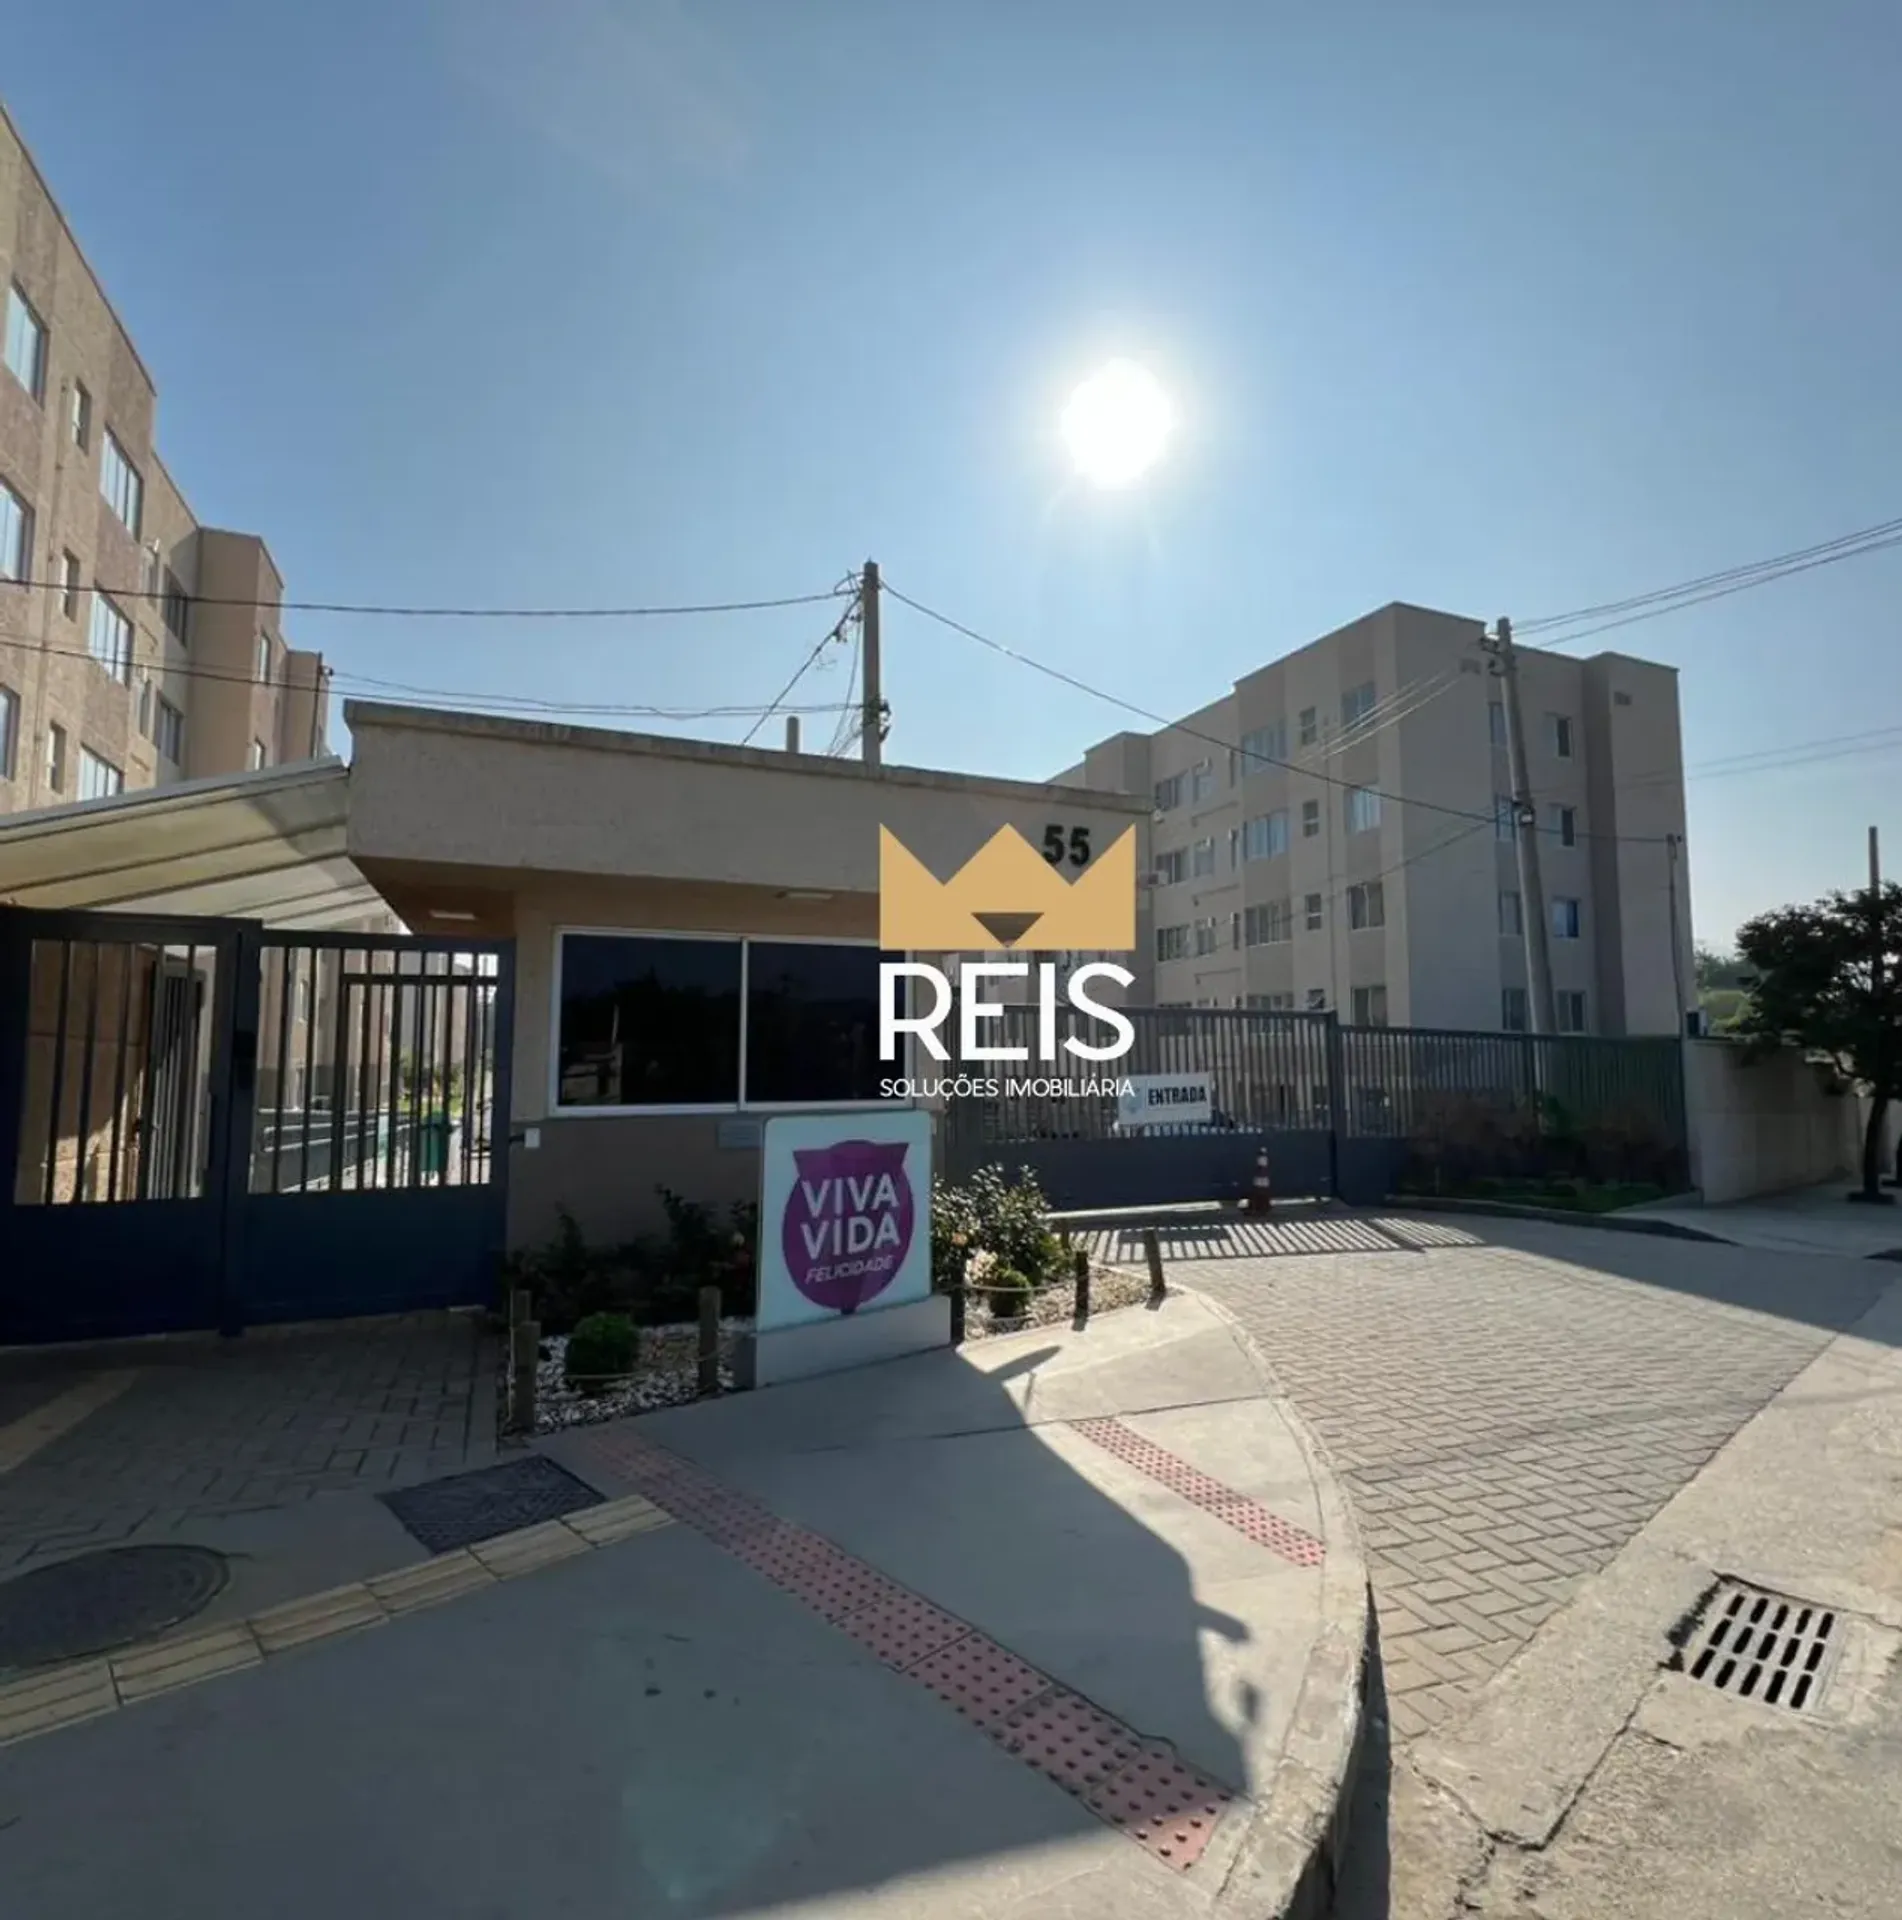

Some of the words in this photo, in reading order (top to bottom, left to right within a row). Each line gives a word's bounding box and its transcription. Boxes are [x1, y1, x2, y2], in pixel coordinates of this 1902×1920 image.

[1043, 825, 1090, 867] 55
[1148, 1086, 1207, 1105] ENTRADA
[801, 1173, 900, 1218] VIVA
[801, 1212, 901, 1260] VIDA
[804, 1255, 894, 1284] FELICIDADE
